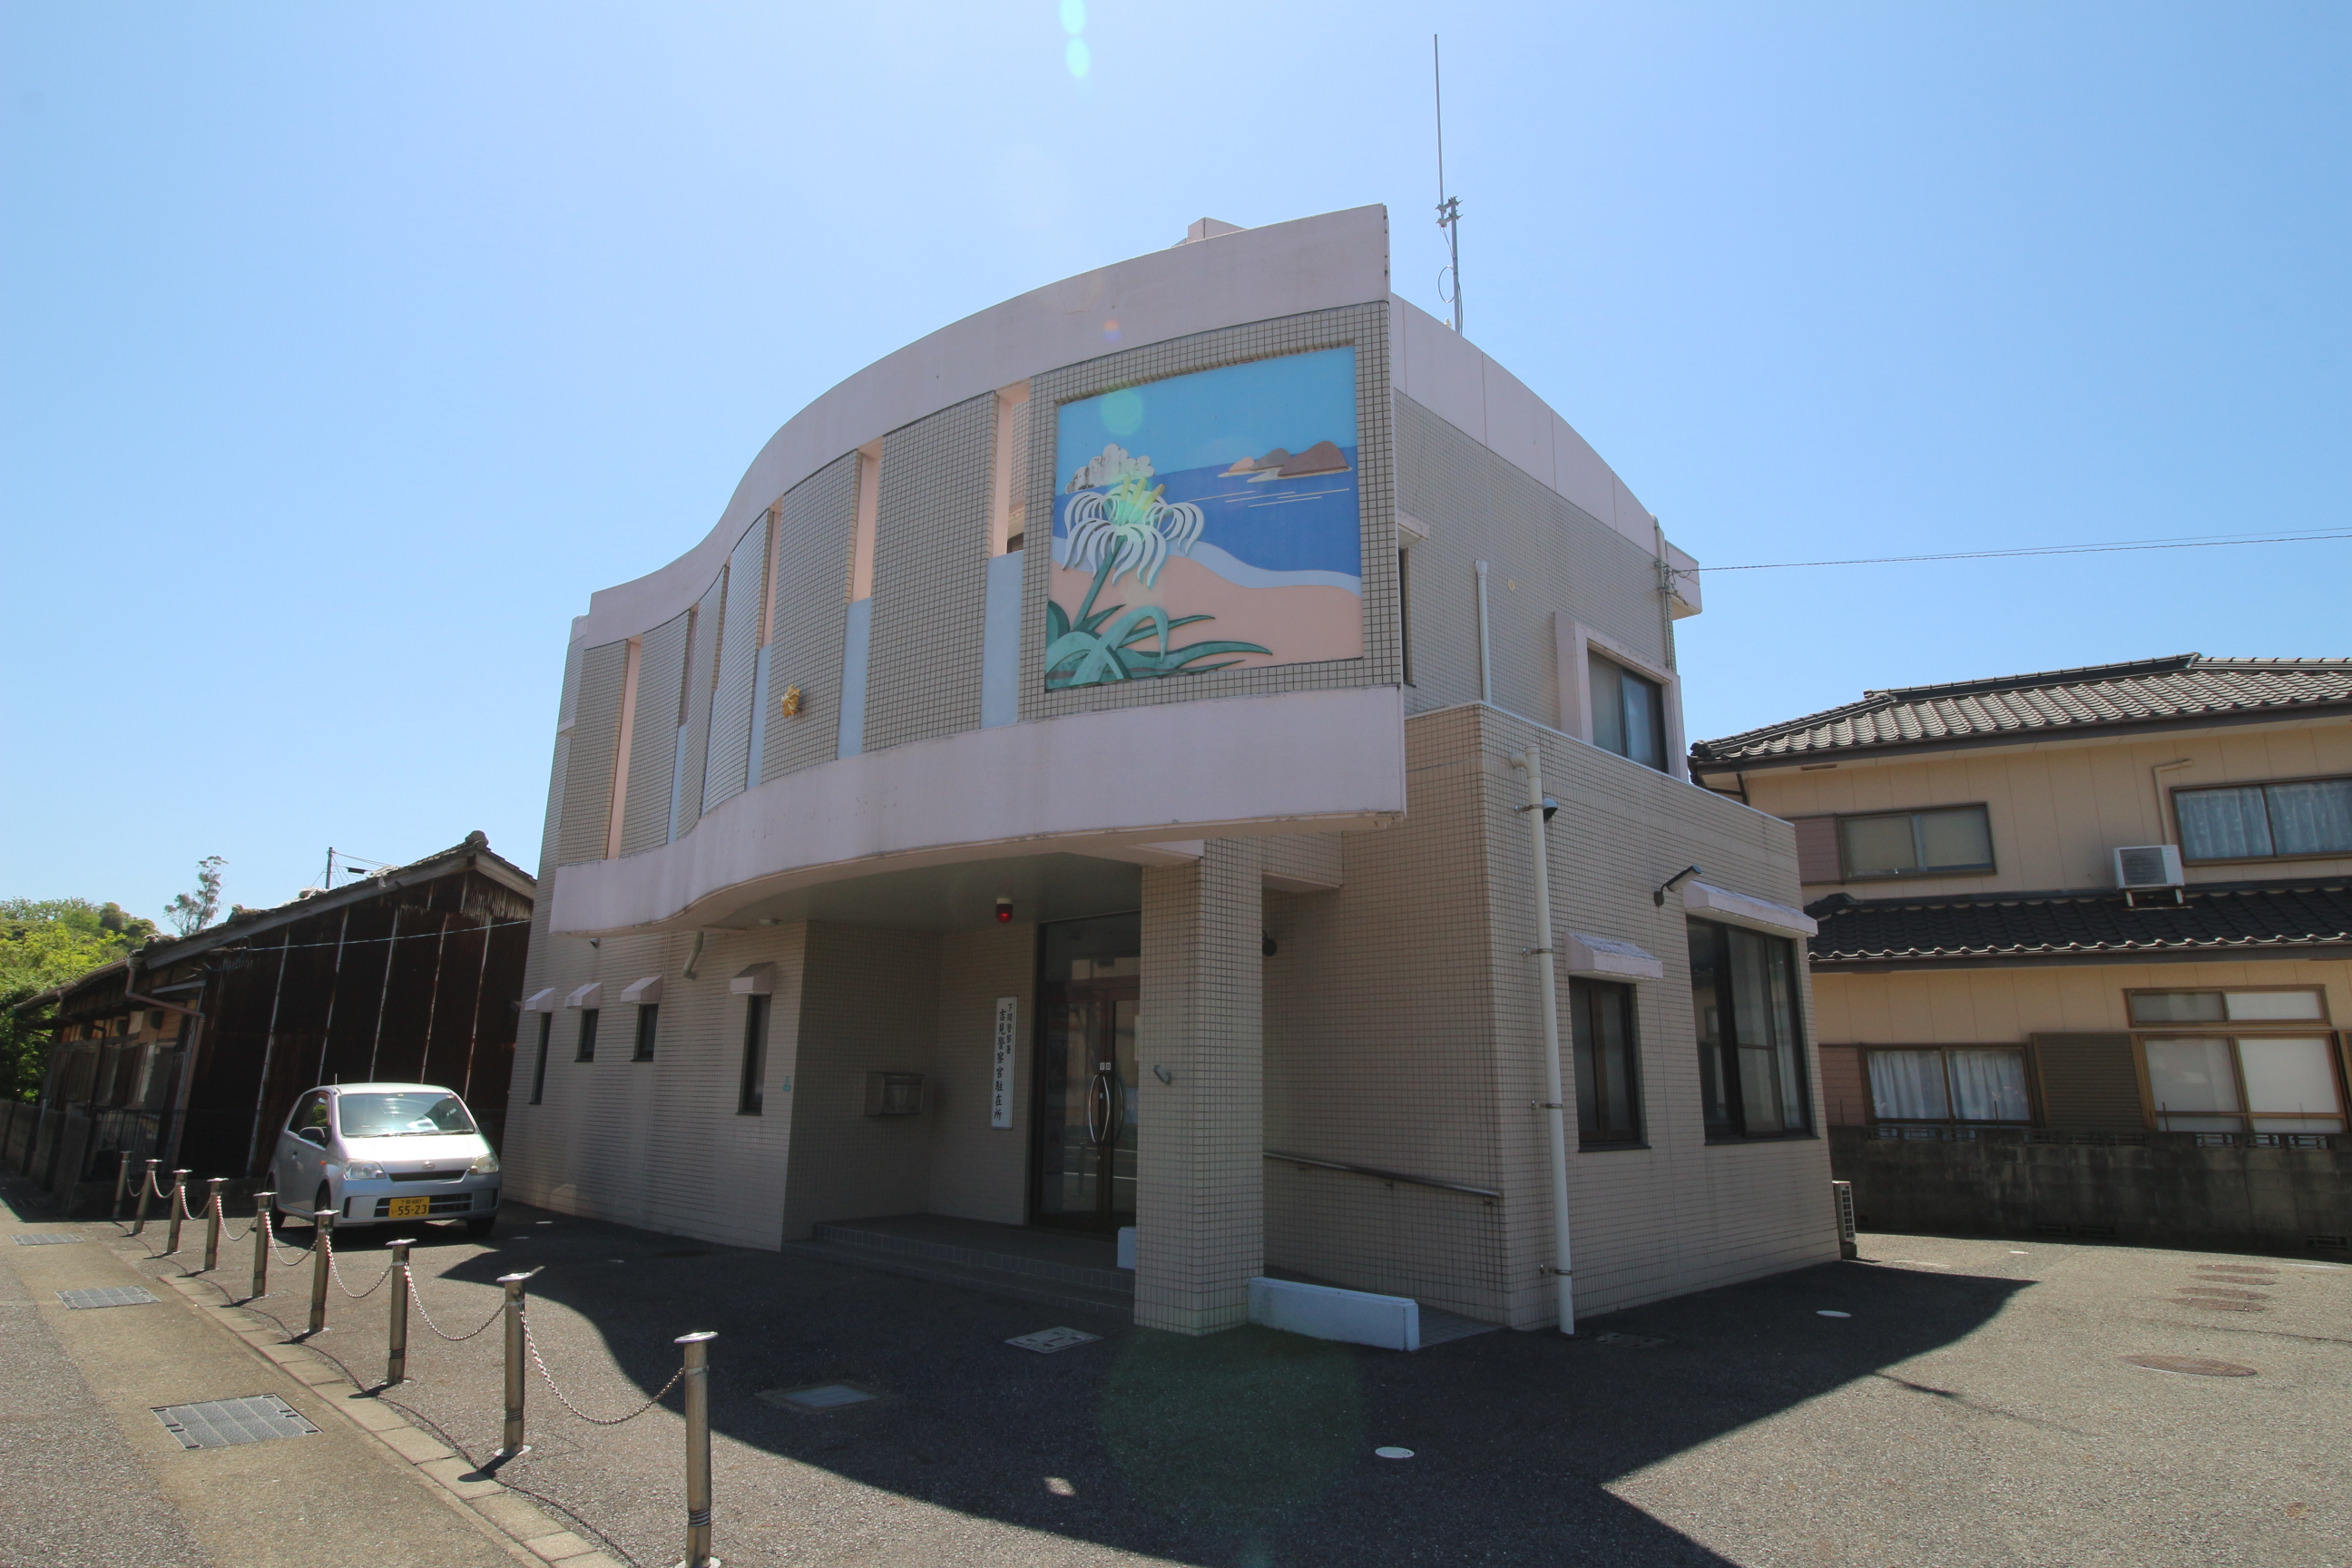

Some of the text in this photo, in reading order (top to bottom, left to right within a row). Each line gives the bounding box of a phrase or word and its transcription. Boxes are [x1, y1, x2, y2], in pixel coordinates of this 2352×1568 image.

[994, 1008, 1006, 1121] 吉見警察官駐在所
[397, 1204, 427, 1216] 55-23
